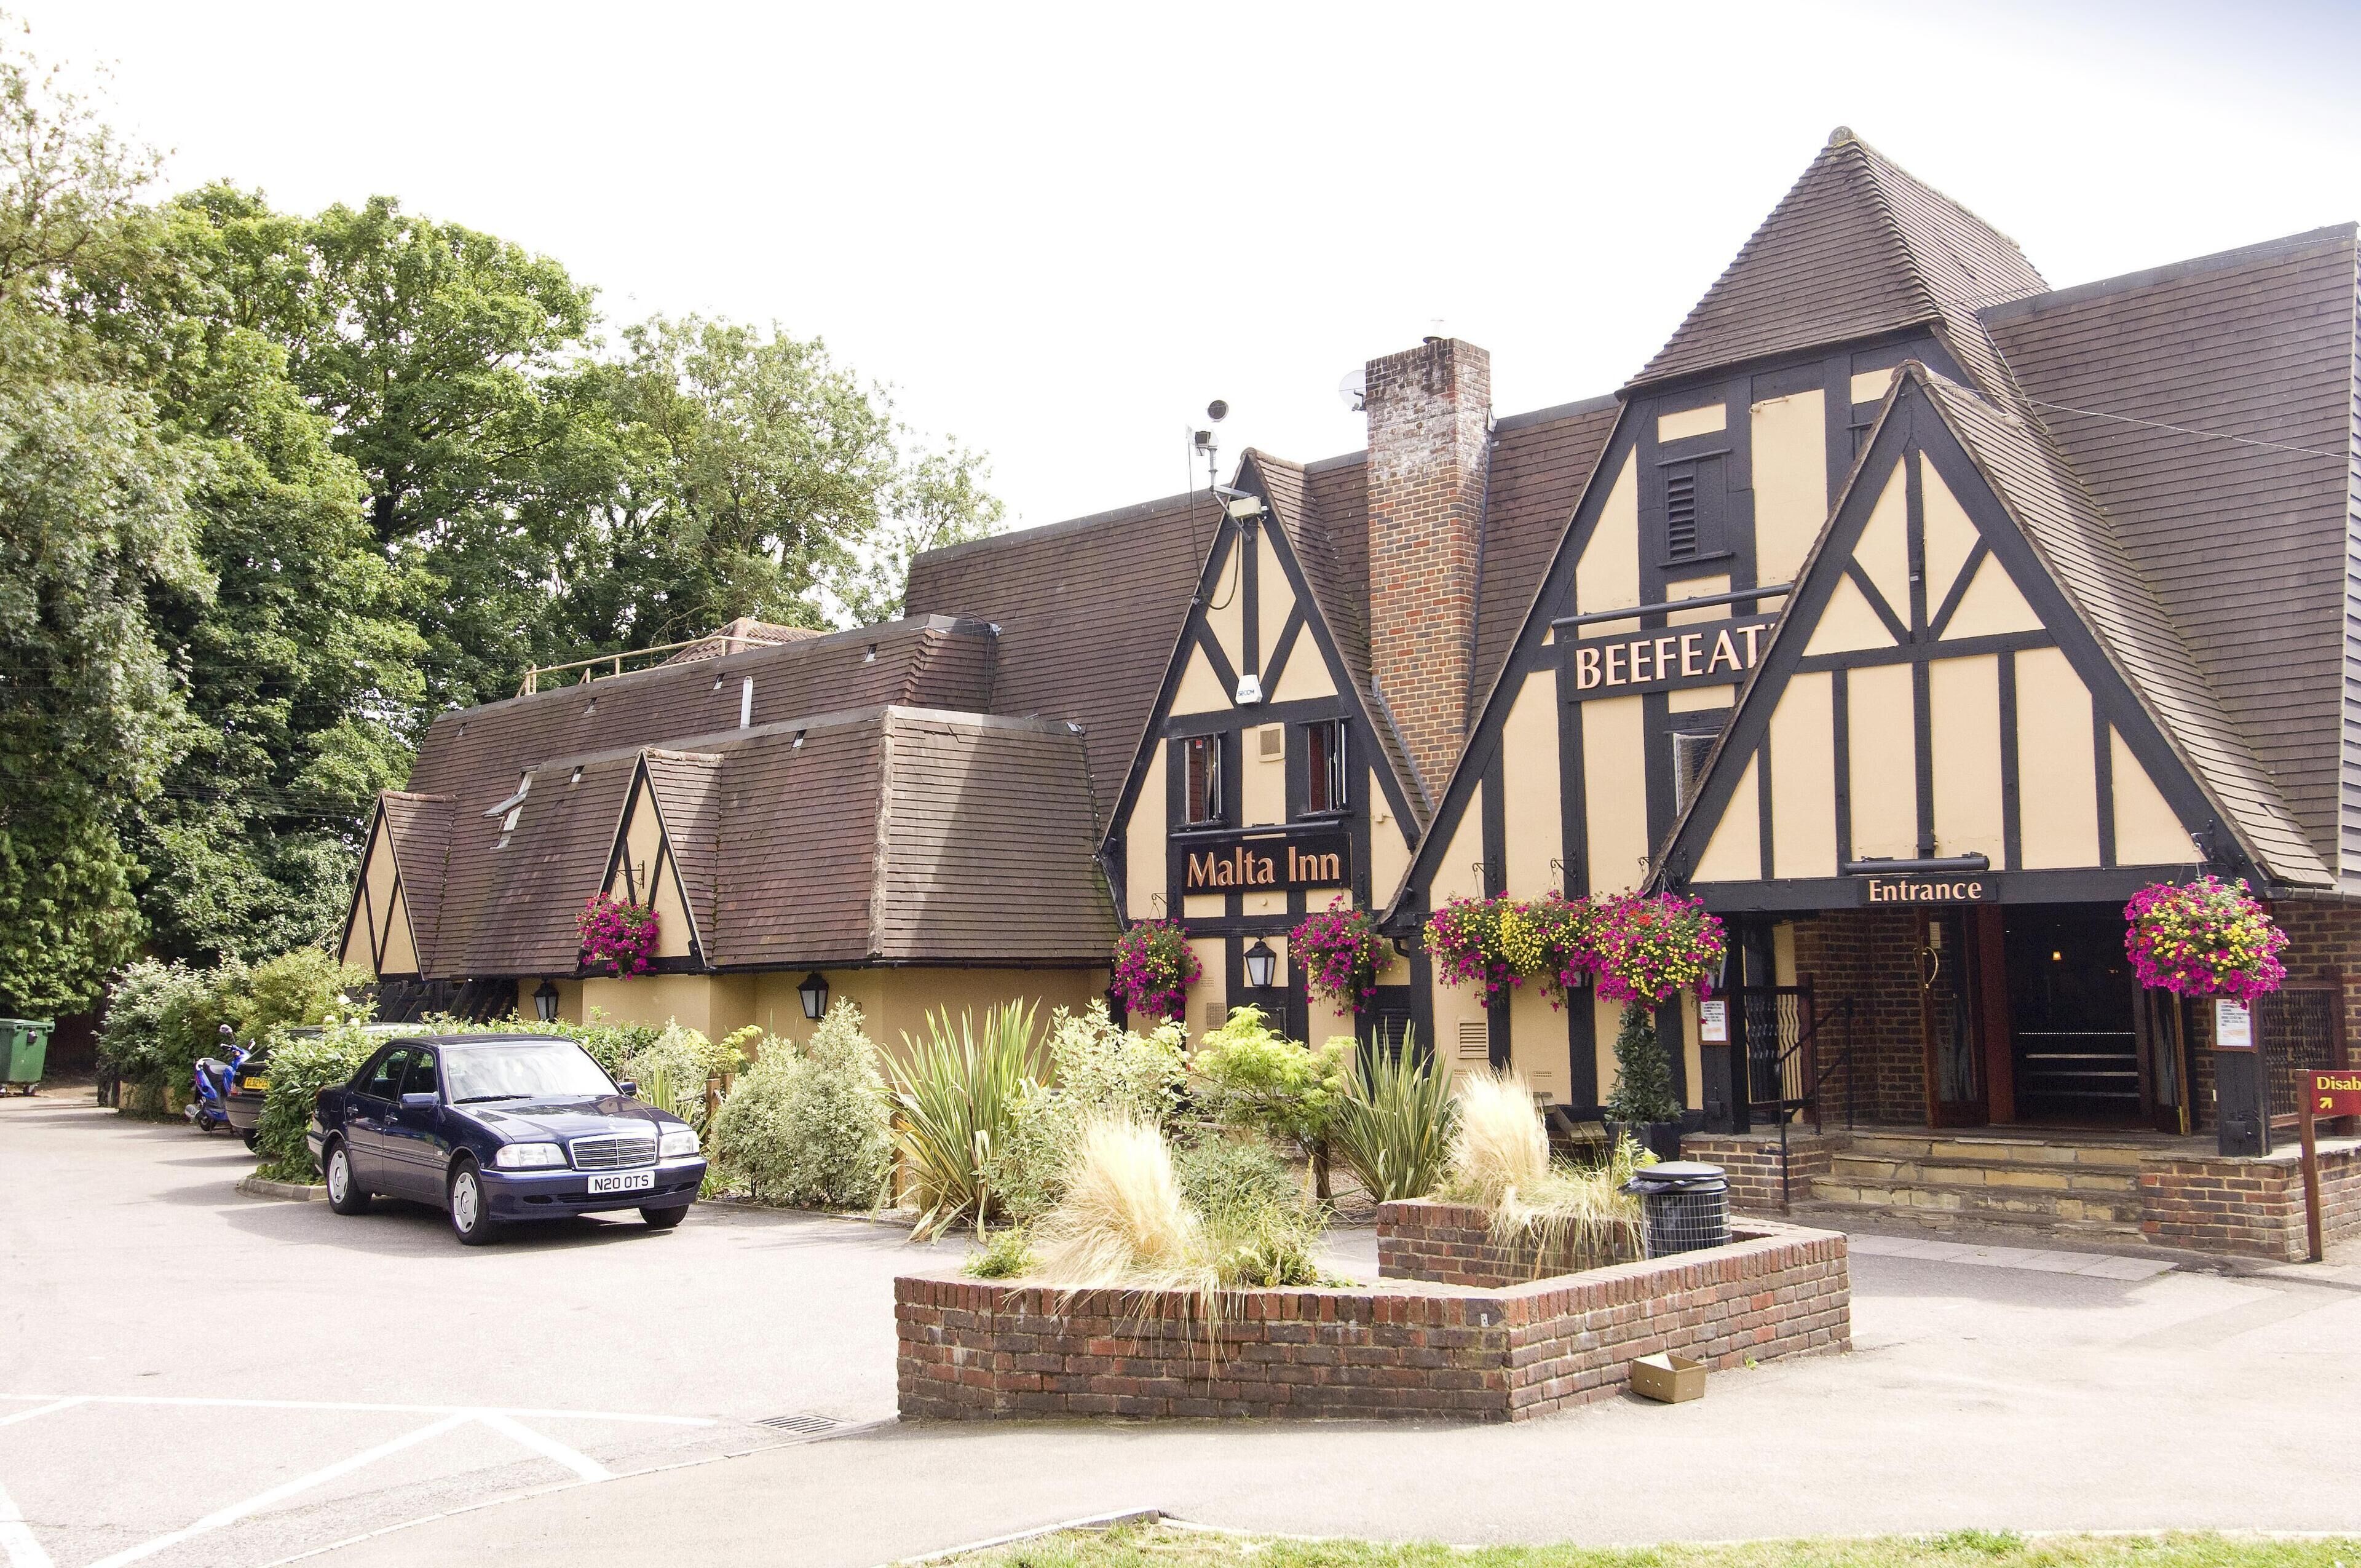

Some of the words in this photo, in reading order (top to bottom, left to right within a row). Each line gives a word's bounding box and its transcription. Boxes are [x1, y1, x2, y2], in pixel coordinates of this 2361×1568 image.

[1575, 623, 1776, 690] BEEFEAT
[1187, 846, 1276, 887] Malta
[1288, 845, 1340, 882] Inn
[1869, 879, 1983, 902] Entrance
[594, 1177, 620, 1191] N20
[624, 1175, 649, 1188] OTS
